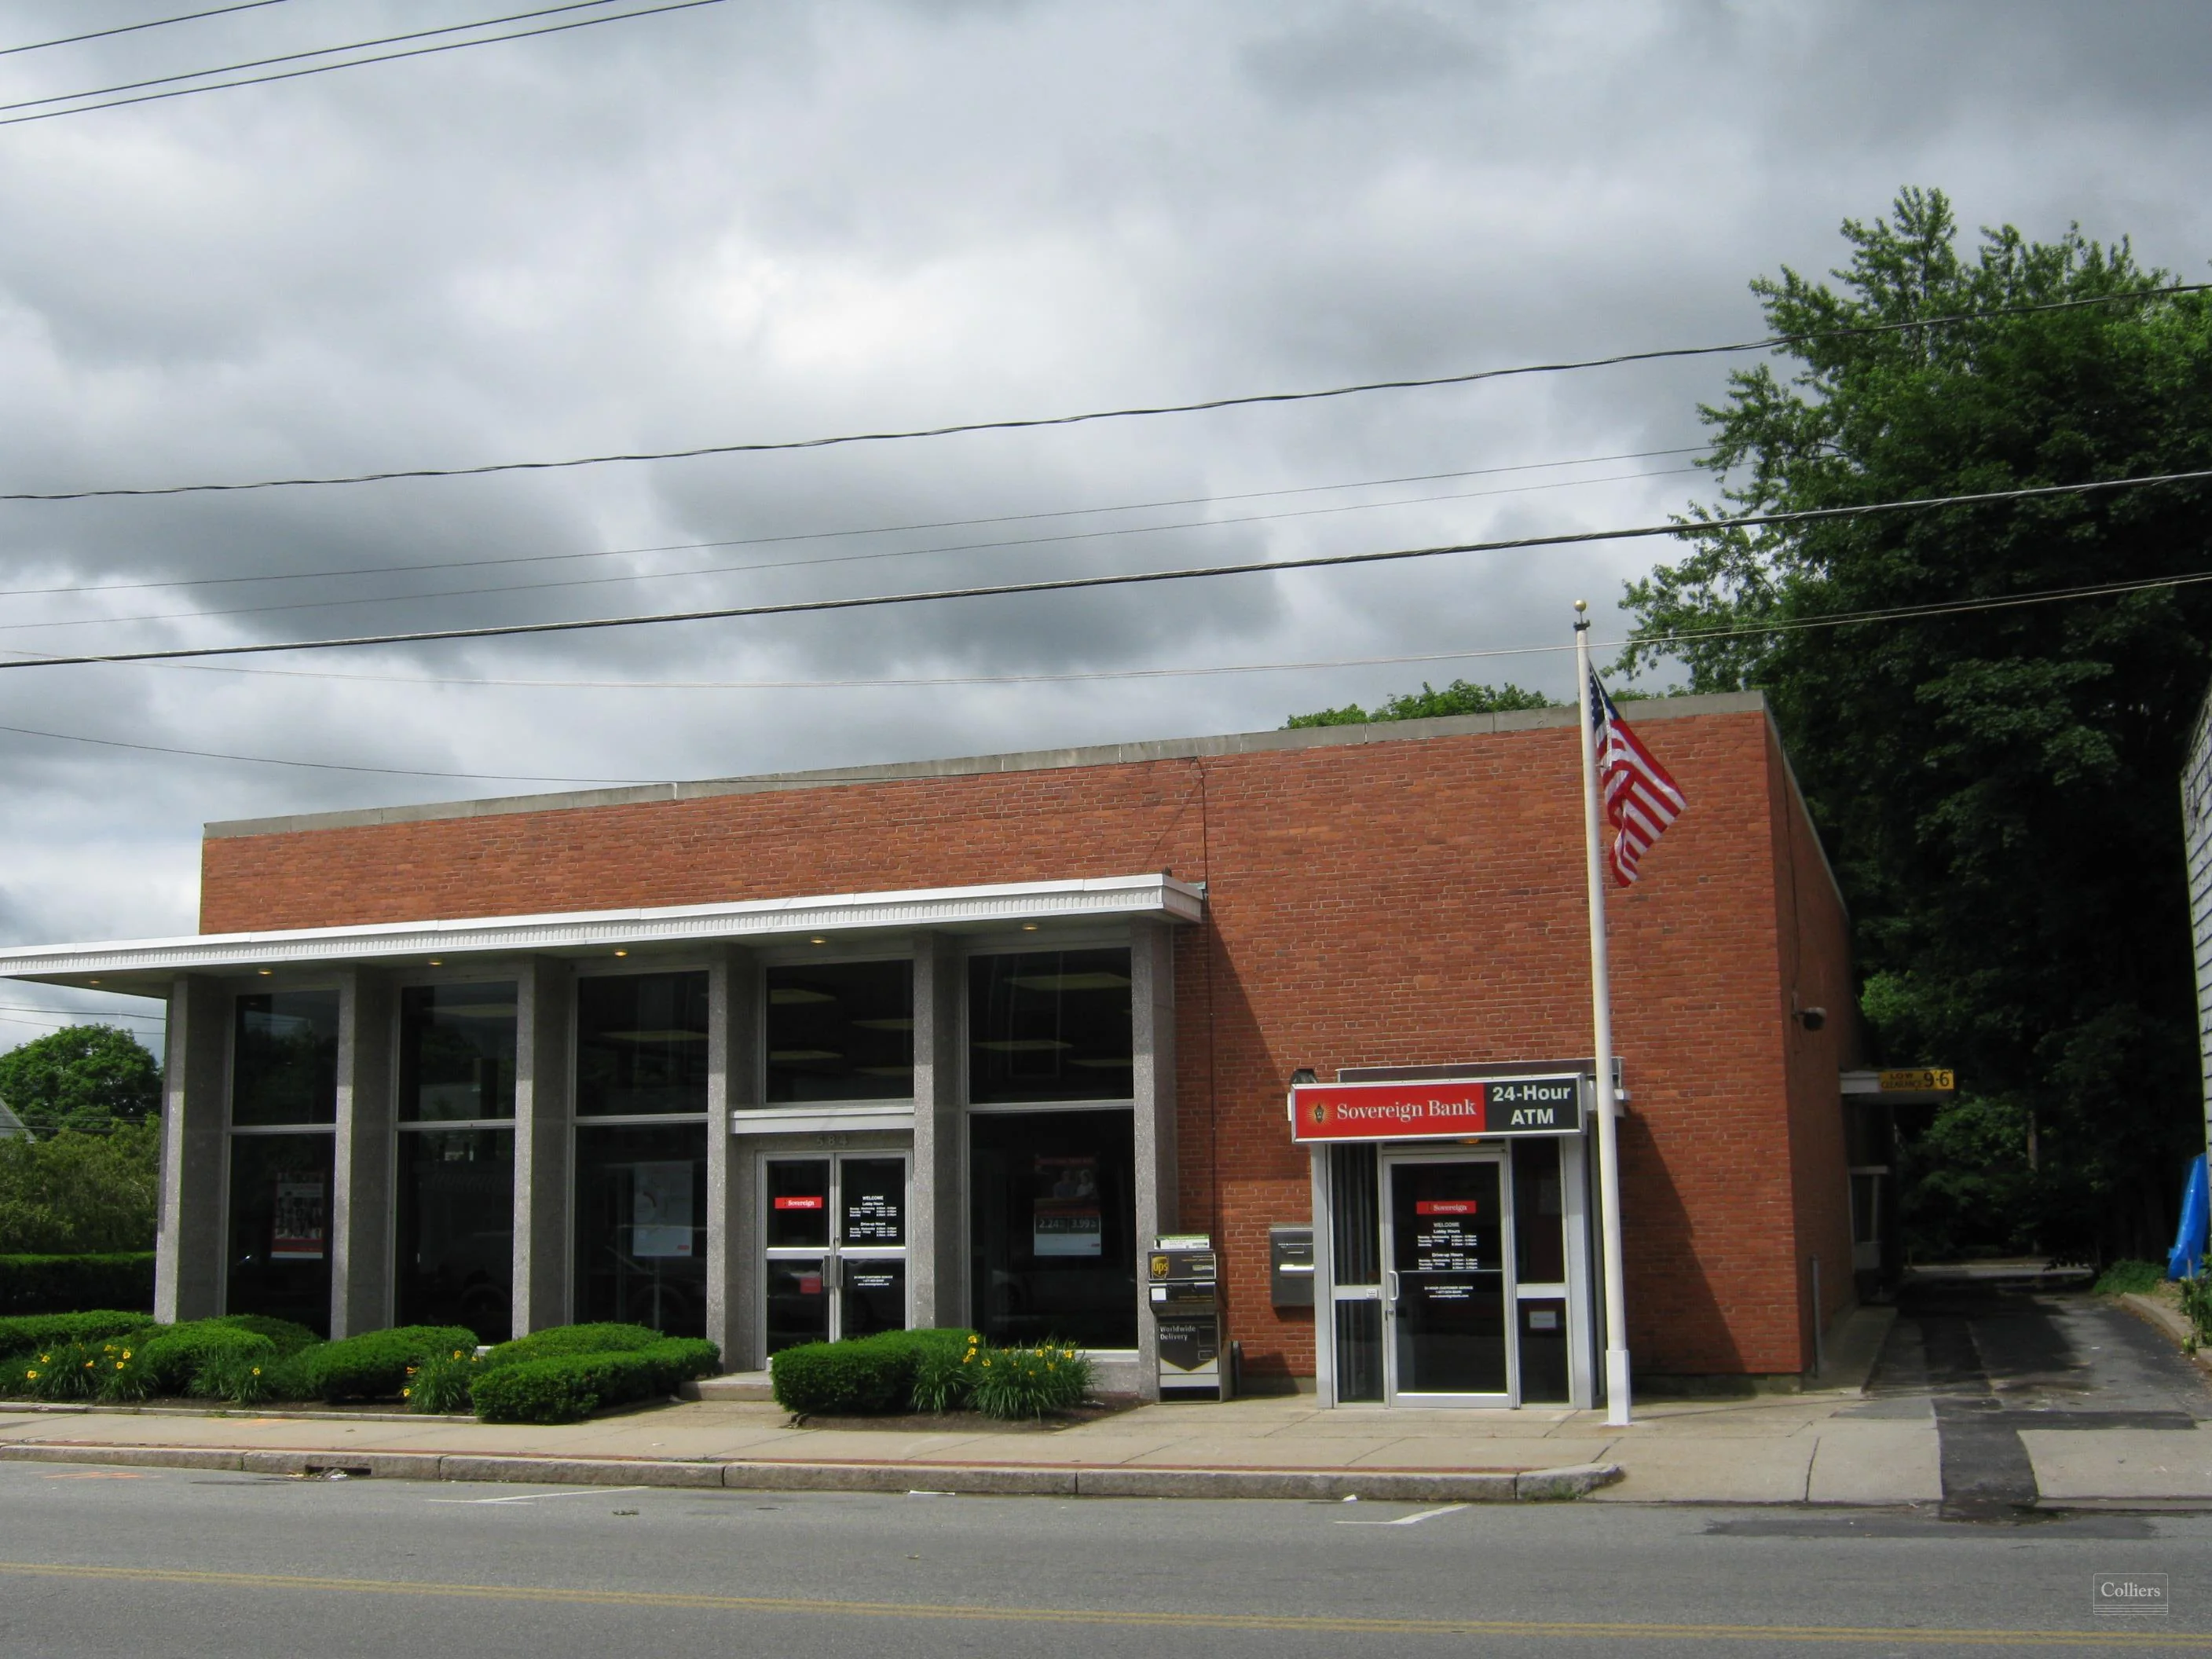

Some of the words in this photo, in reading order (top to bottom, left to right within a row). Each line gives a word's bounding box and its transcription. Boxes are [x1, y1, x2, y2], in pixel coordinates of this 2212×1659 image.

[1492, 1085, 1571, 1102] 24-Hour
[1337, 1101, 1423, 1122] Sovereign
[1427, 1099, 1478, 1117] Bank
[1510, 1108, 1554, 1126] ATM
[788, 1199, 815, 1208] Sovereign
[1433, 1203, 1468, 1213] Sovereign
[1159, 1333, 1188, 1342] Delivery
